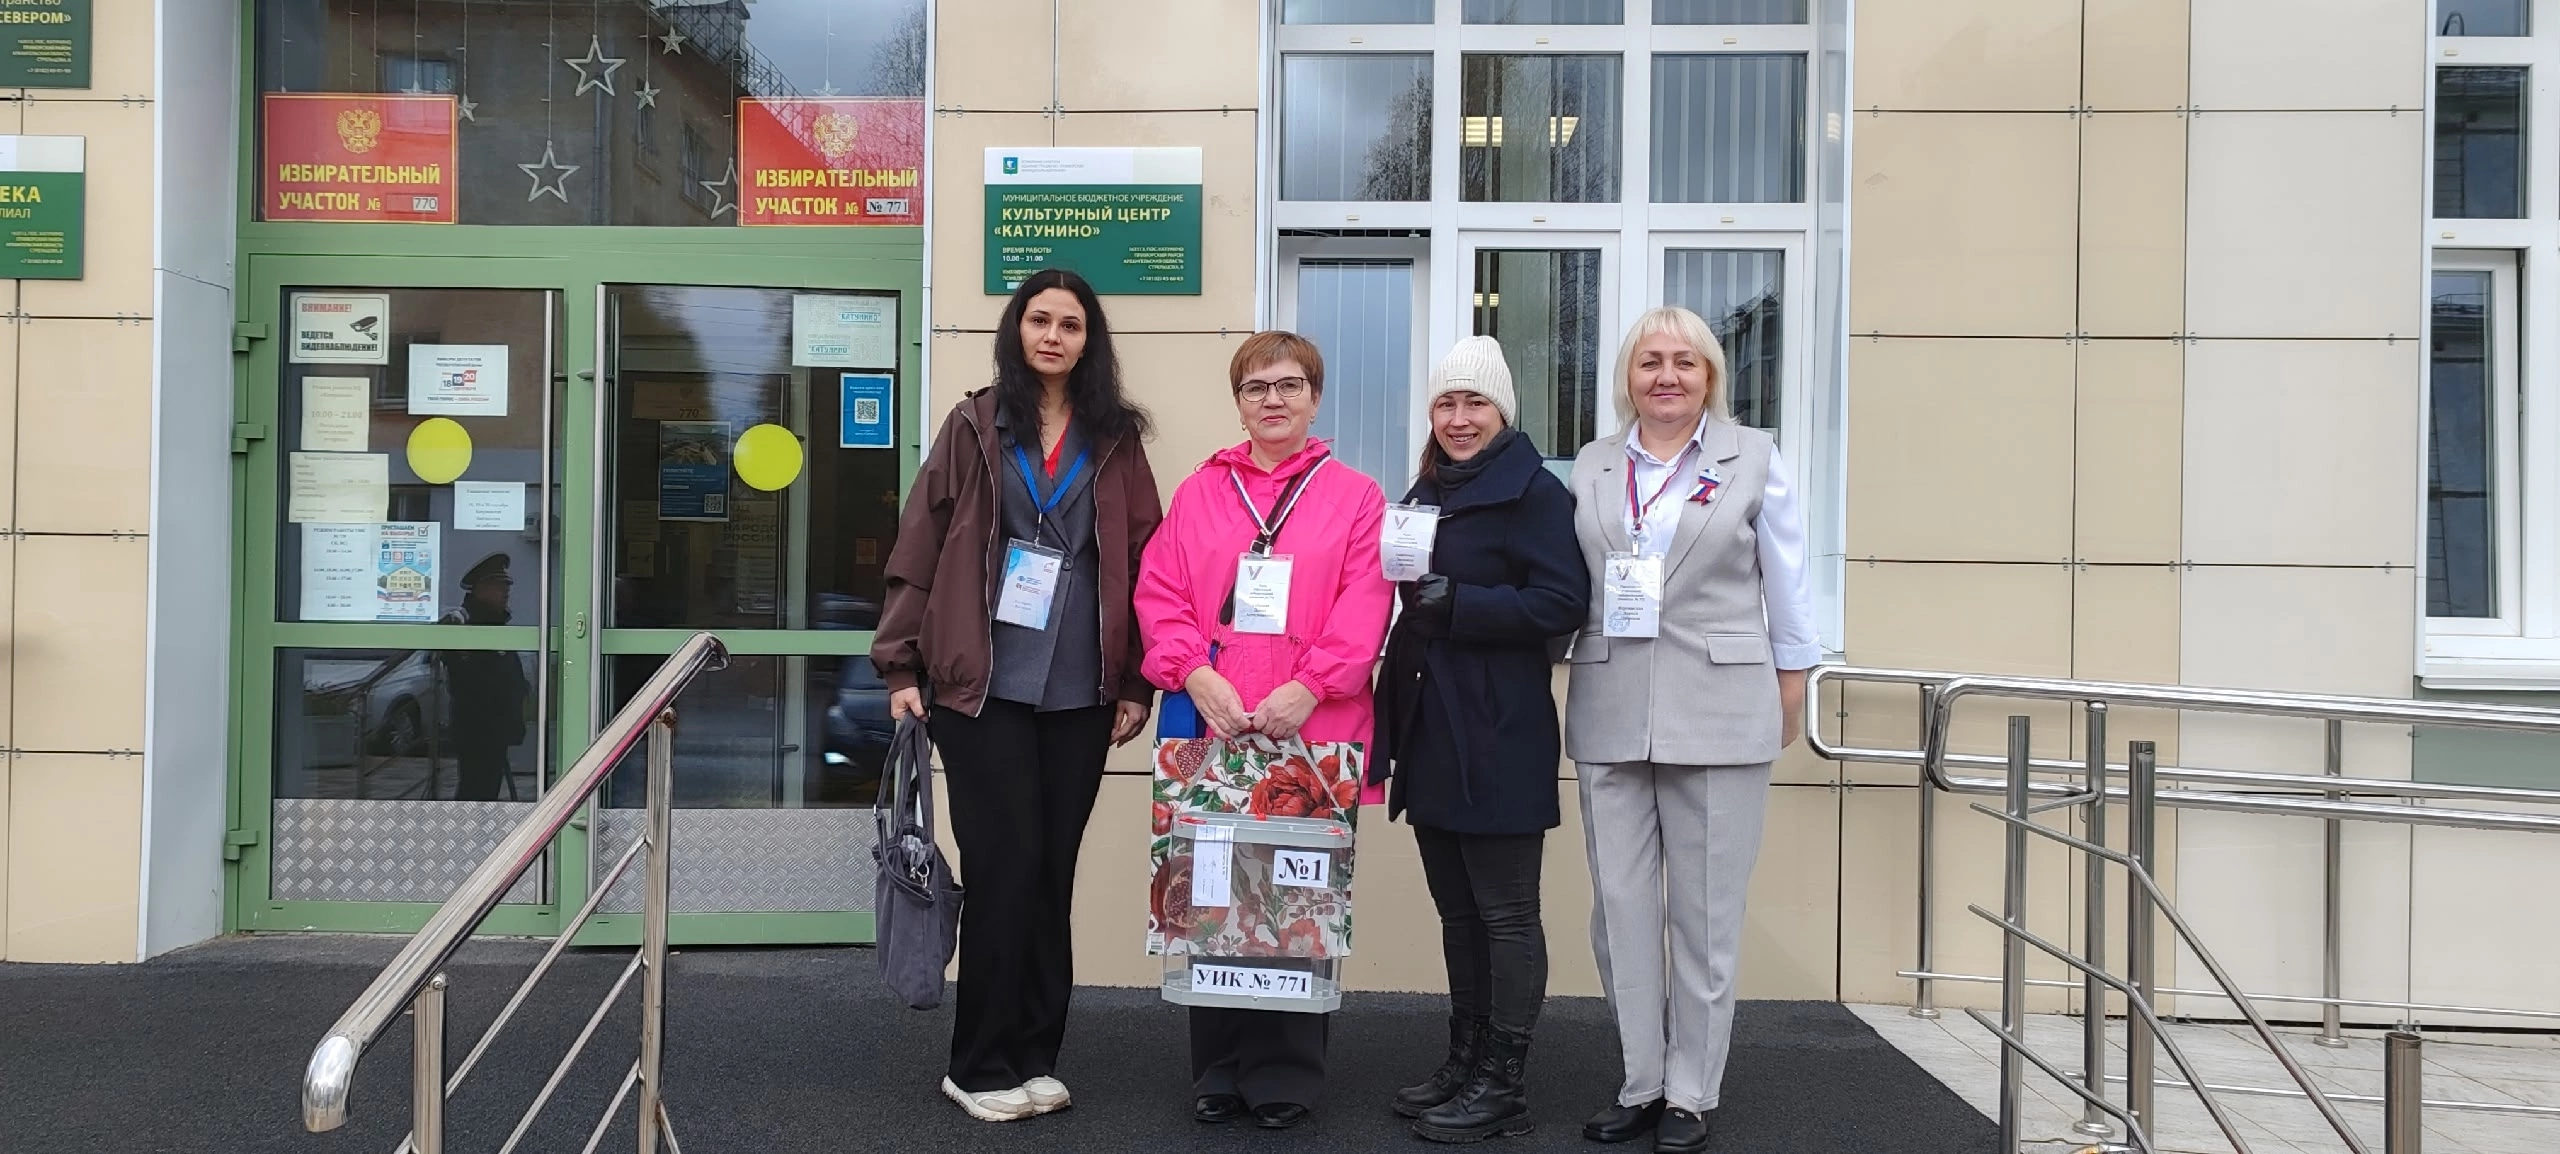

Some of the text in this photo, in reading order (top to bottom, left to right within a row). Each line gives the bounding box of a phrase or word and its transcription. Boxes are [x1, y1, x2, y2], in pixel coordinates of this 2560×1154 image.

[279, 163, 440, 185] ИЗБИРАТЕЛЬНЫЙ
[756, 166, 918, 188] ИЗБИРАТЕЛЬНЫЙ
[0, 186, 41, 203] ЕКА
[279, 191, 437, 211] УЧАСТОК № 770
[1002, 194, 1184, 203] МУНИЦИПАЛЬНОЕ БЮДЖЕТНОЕ УЧРЕЖДЕНИЕ
[755, 197, 908, 215] УЧАСТОК № № 771
[1002, 205, 1171, 223] КУЛЬТУРНЫЙ ЦЕНТР
[994, 224, 1100, 238] «КАТУНИНО»
[301, 303, 352, 313] ВНИМАНИЕ!
[301, 330, 334, 340] ВЕДЕТСЯ
[301, 342, 378, 352] ВИДЕОНАБЛЮДЕНИЕ!
[453, 376, 463, 384] 19
[464, 373, 475, 381] 20
[1278, 857, 1322, 882] №1
[1196, 969, 1307, 993] УИК № 771
